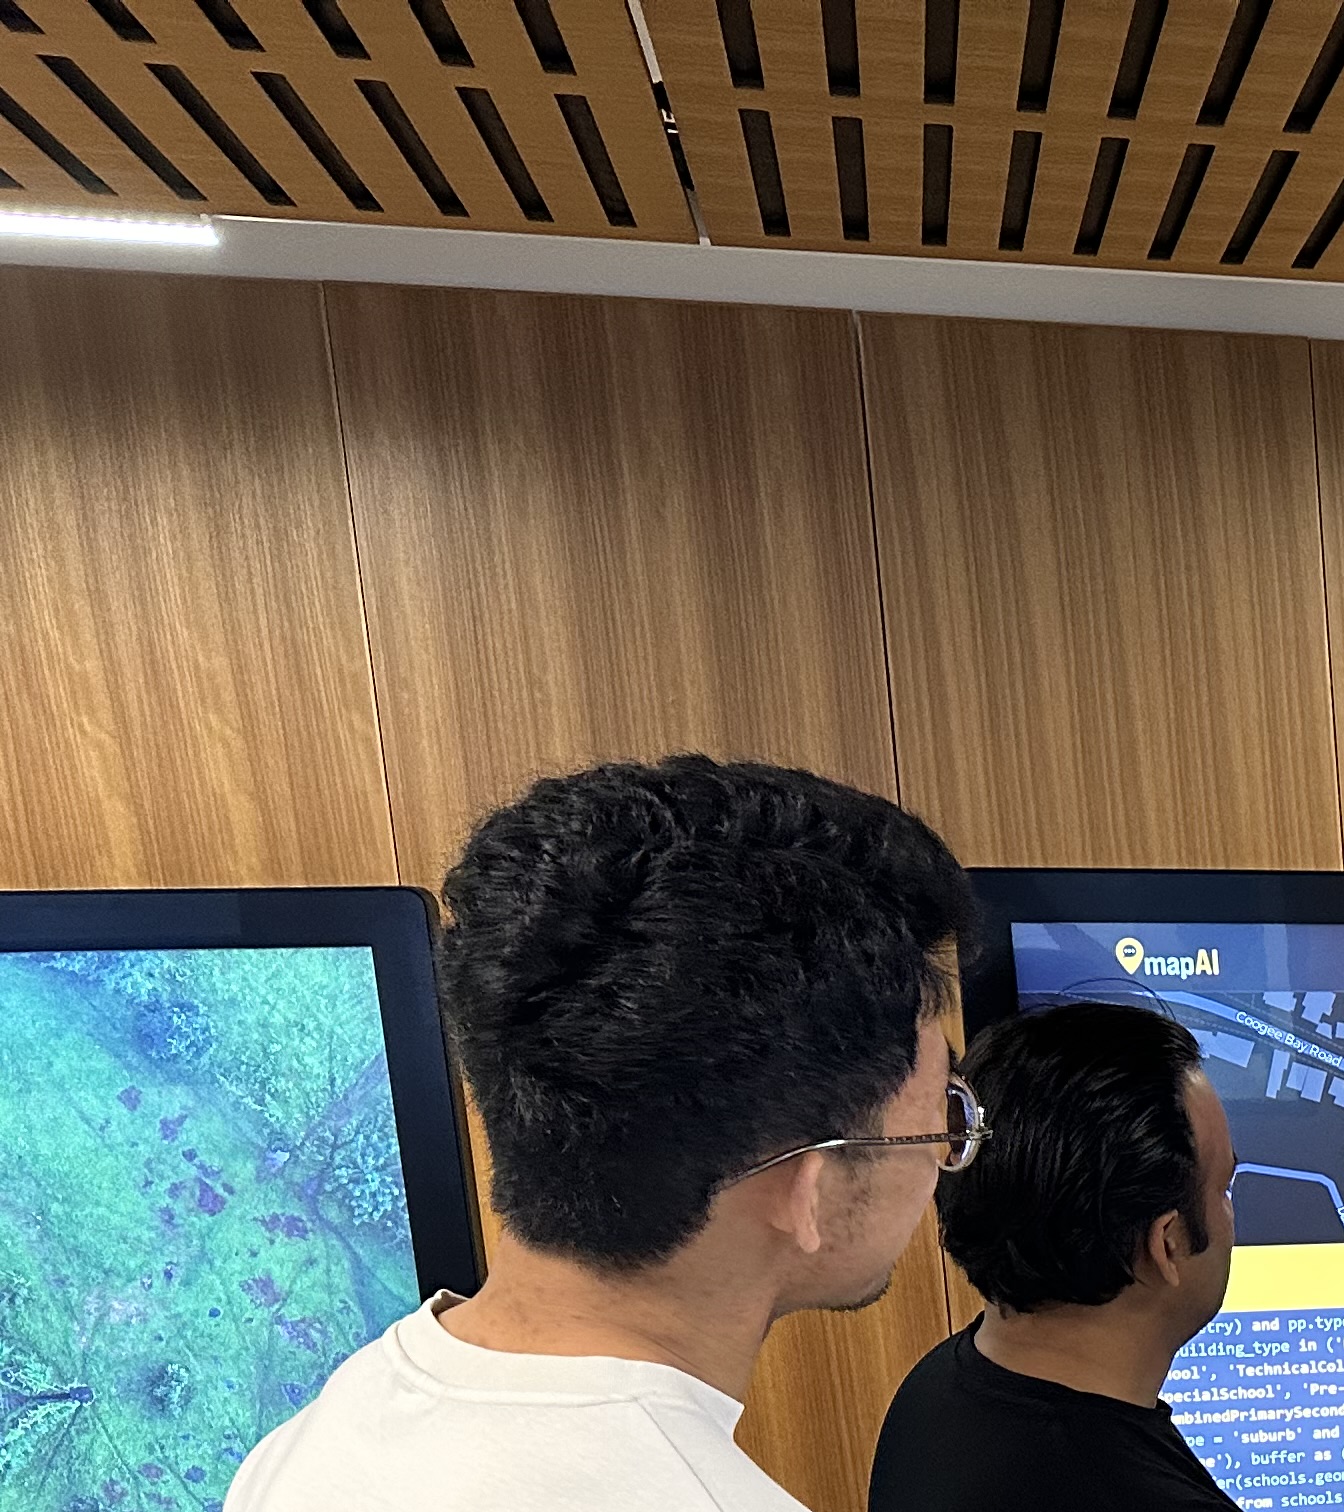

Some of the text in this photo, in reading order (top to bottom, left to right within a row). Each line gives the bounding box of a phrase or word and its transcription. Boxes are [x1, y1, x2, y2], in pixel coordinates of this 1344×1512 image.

[1144, 949, 1220, 980] mapAI
[1235, 1011, 1343, 1068] Coogee Bay Road
[1252, 1317, 1280, 1332] and
[1299, 1338, 1318, 1353] in
[1233, 1427, 1302, 1445] 'suburb'
[1312, 1425, 1340, 1440] and
[1251, 1450, 1306, 1466] buffer
[1313, 1450, 1332, 1462] as
[1236, 1496, 1273, 1510] from
